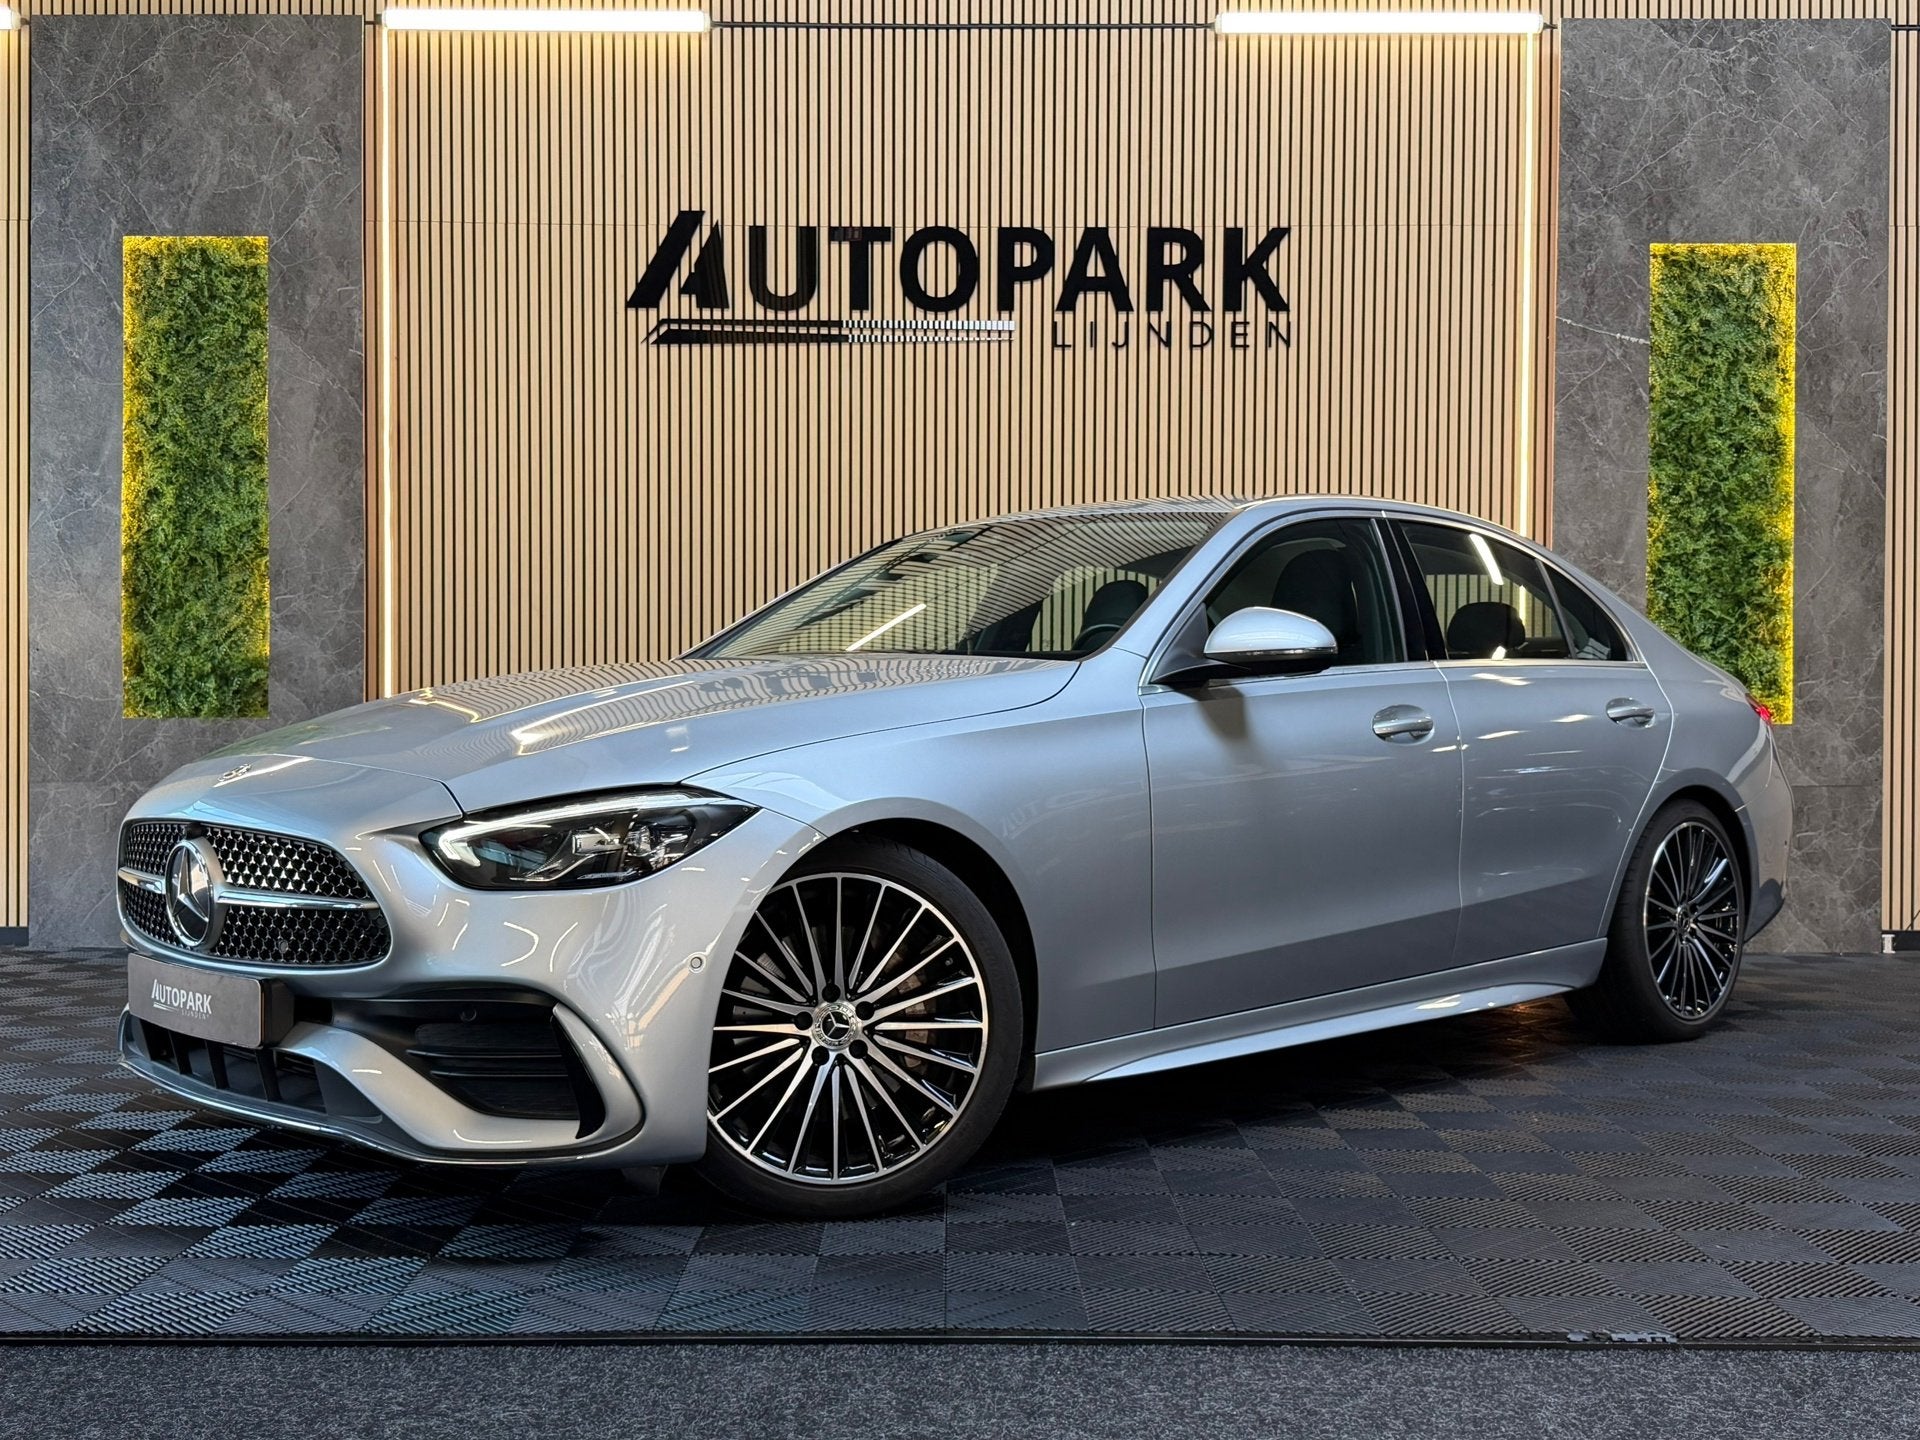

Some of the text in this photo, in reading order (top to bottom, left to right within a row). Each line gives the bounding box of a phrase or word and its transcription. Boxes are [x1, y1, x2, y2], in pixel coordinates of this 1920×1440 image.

[625, 211, 1291, 313] AUTOPARK
[1053, 321, 1291, 348] LIJNDEN
[151, 978, 212, 1014] AUTOPARK
